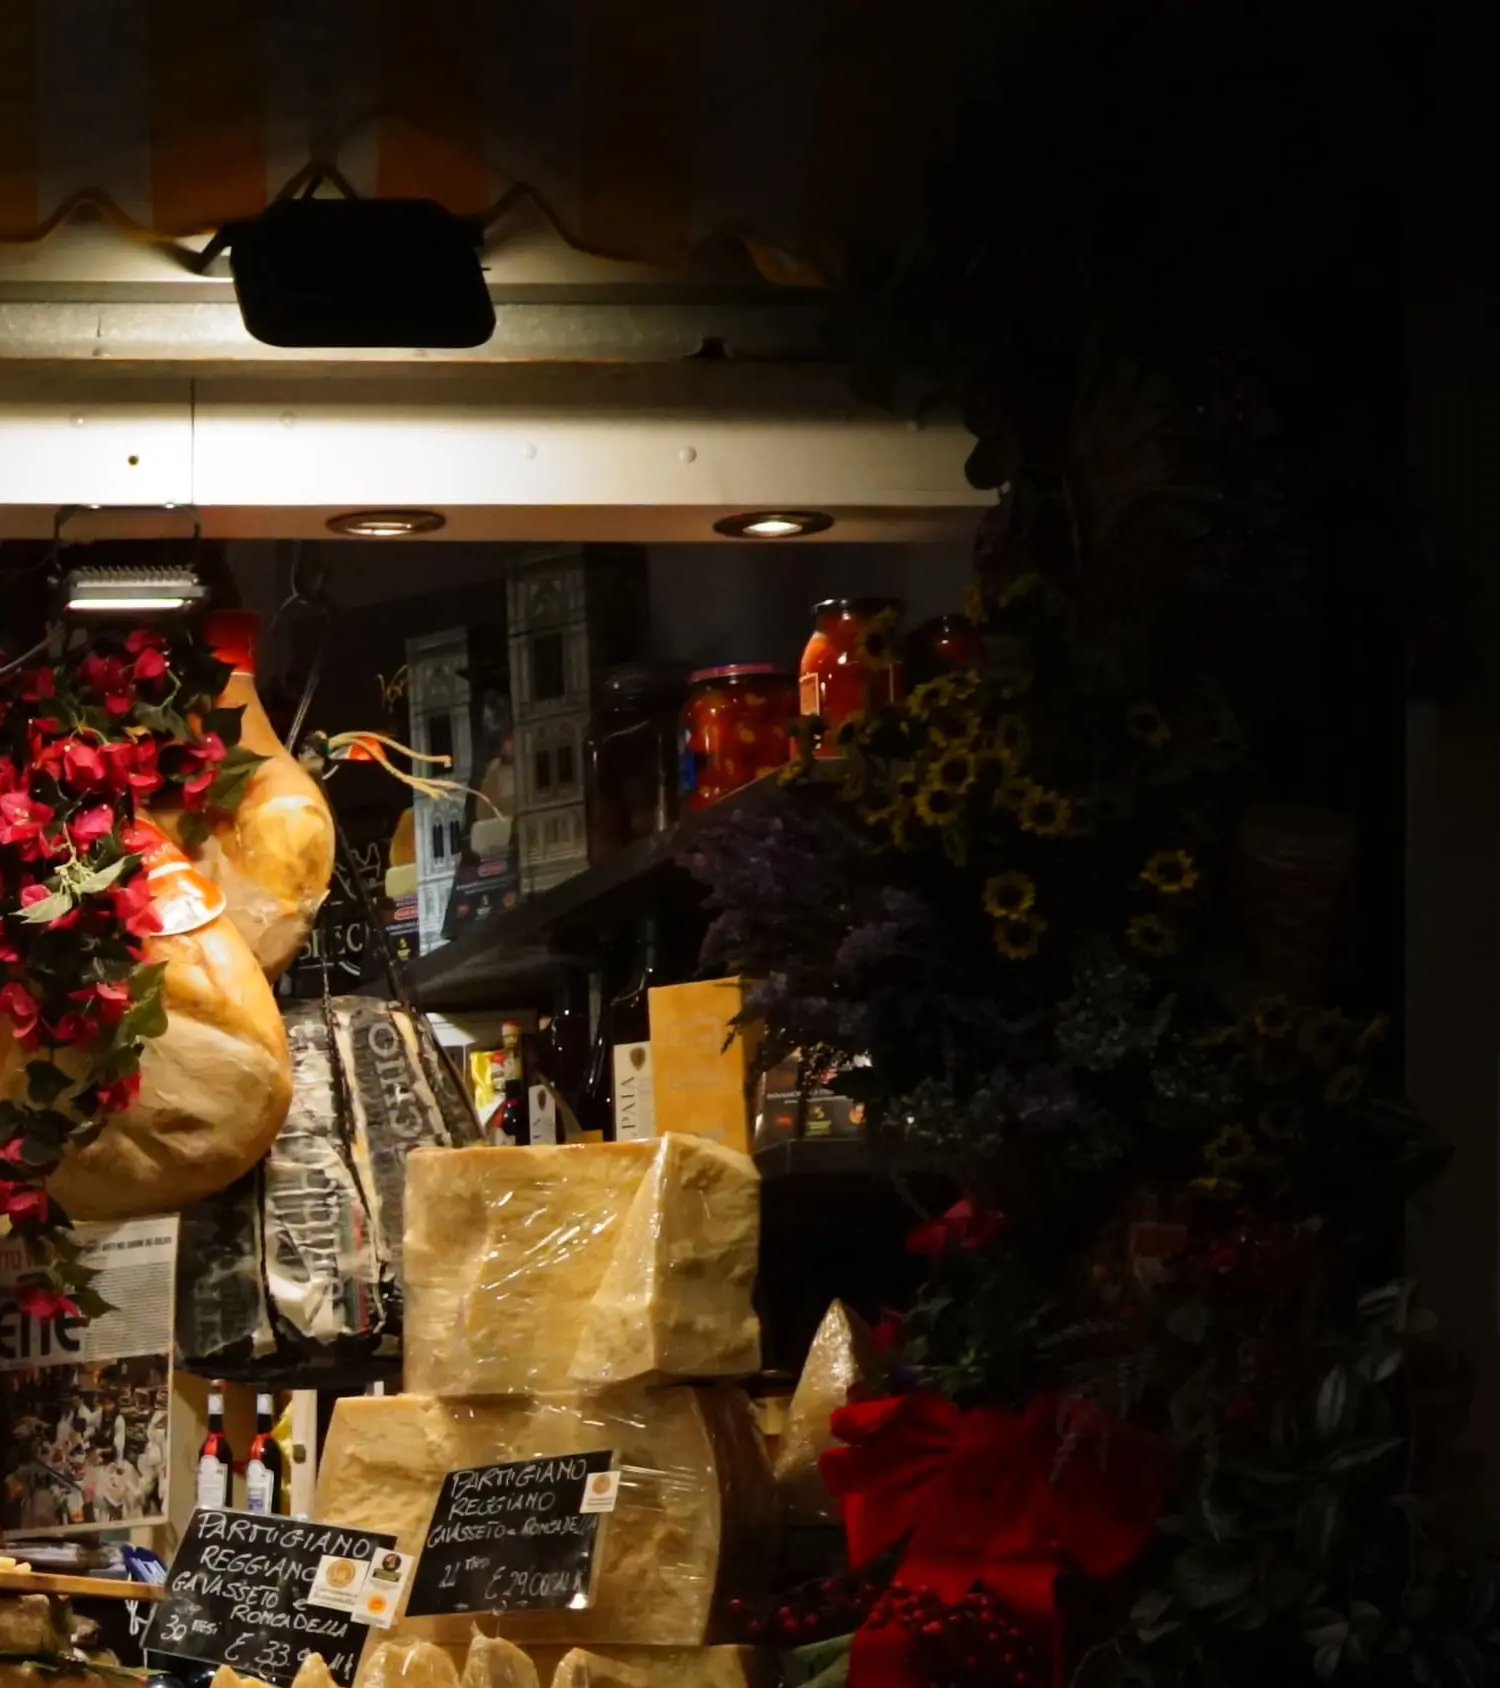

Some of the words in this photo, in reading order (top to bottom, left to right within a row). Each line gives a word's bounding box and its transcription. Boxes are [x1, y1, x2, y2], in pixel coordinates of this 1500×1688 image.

[451, 1458, 588, 1499] PARMIGIANO
[448, 1491, 556, 1520] REGGIANO
[197, 1511, 372, 1558] PARMIGIANO
[200, 1544, 318, 1583] REGGIANO
[223, 1632, 255, 1662] €
